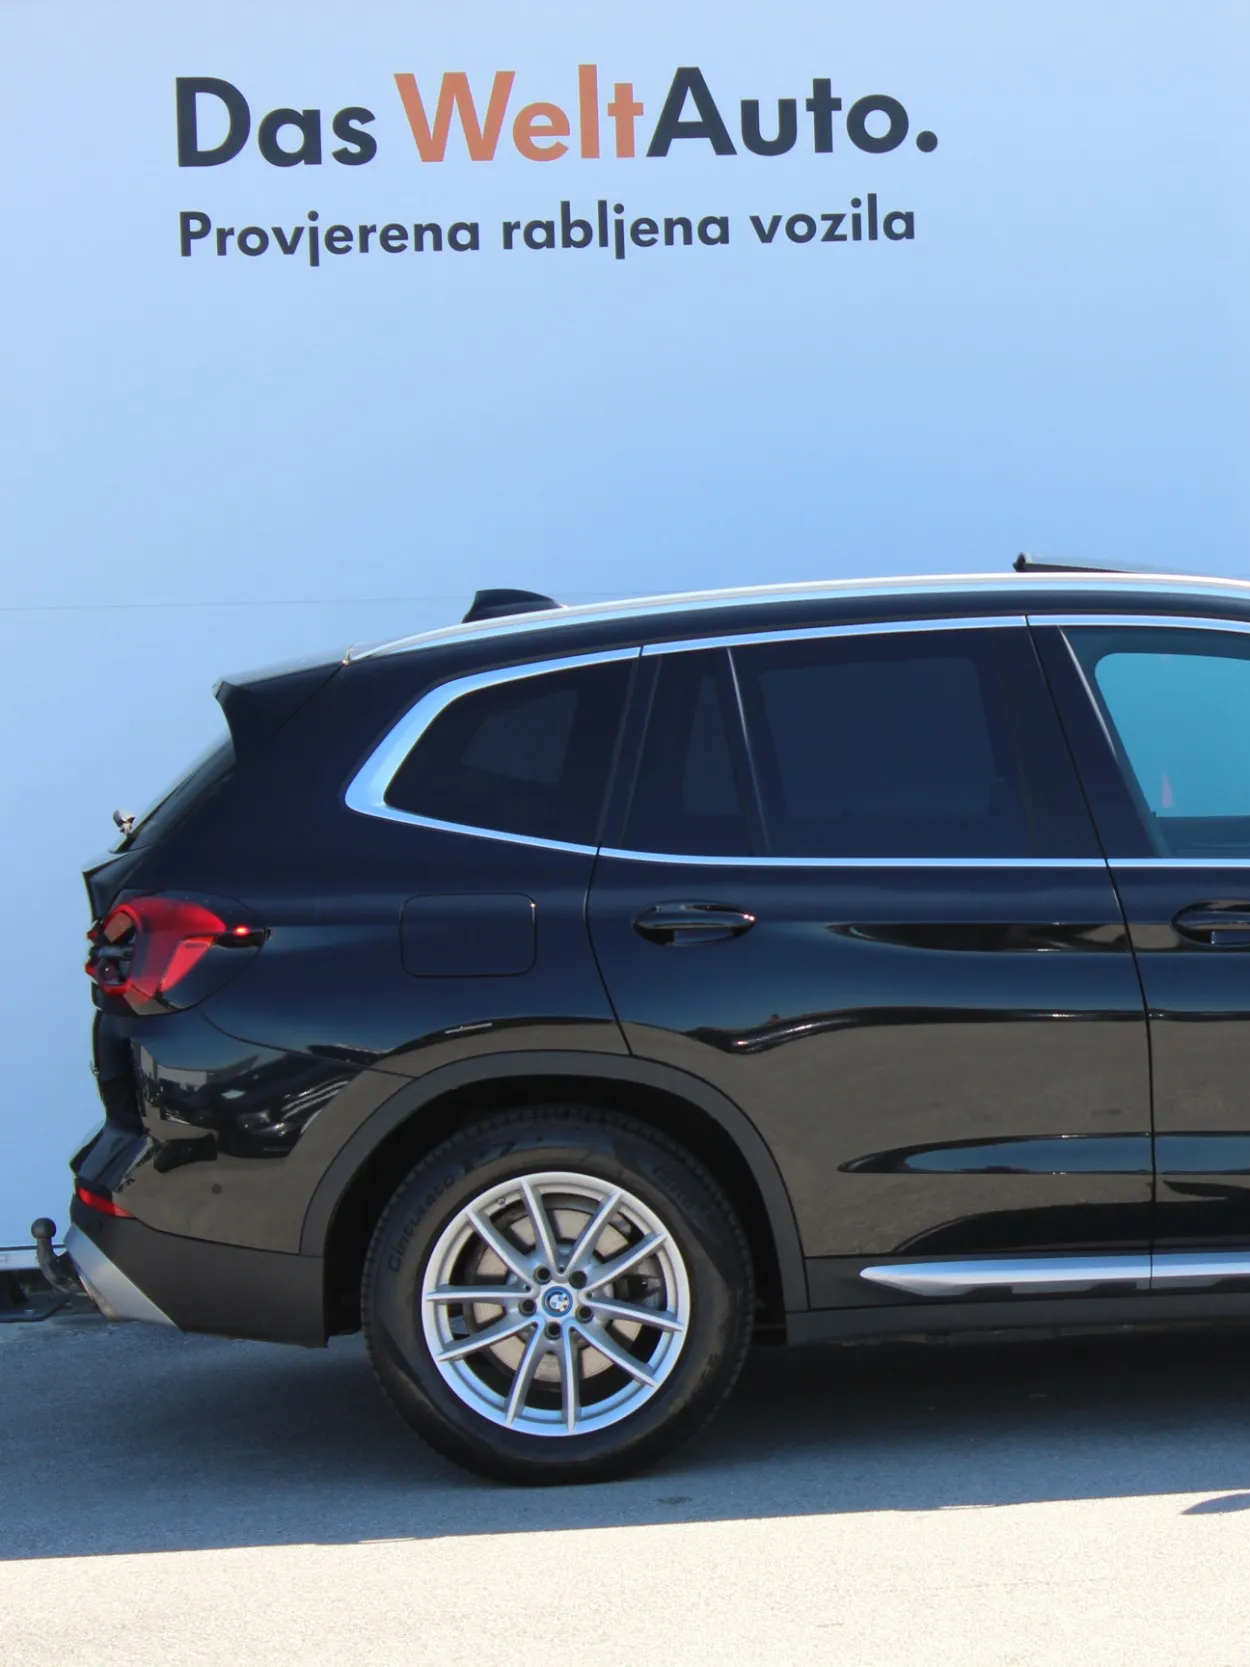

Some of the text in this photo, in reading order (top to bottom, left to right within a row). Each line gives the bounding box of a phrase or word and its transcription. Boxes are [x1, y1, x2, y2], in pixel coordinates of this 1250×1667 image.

[175, 63, 939, 168] Das WeltAuto.
[179, 192, 916, 267] Provjerena rabljena vozila
